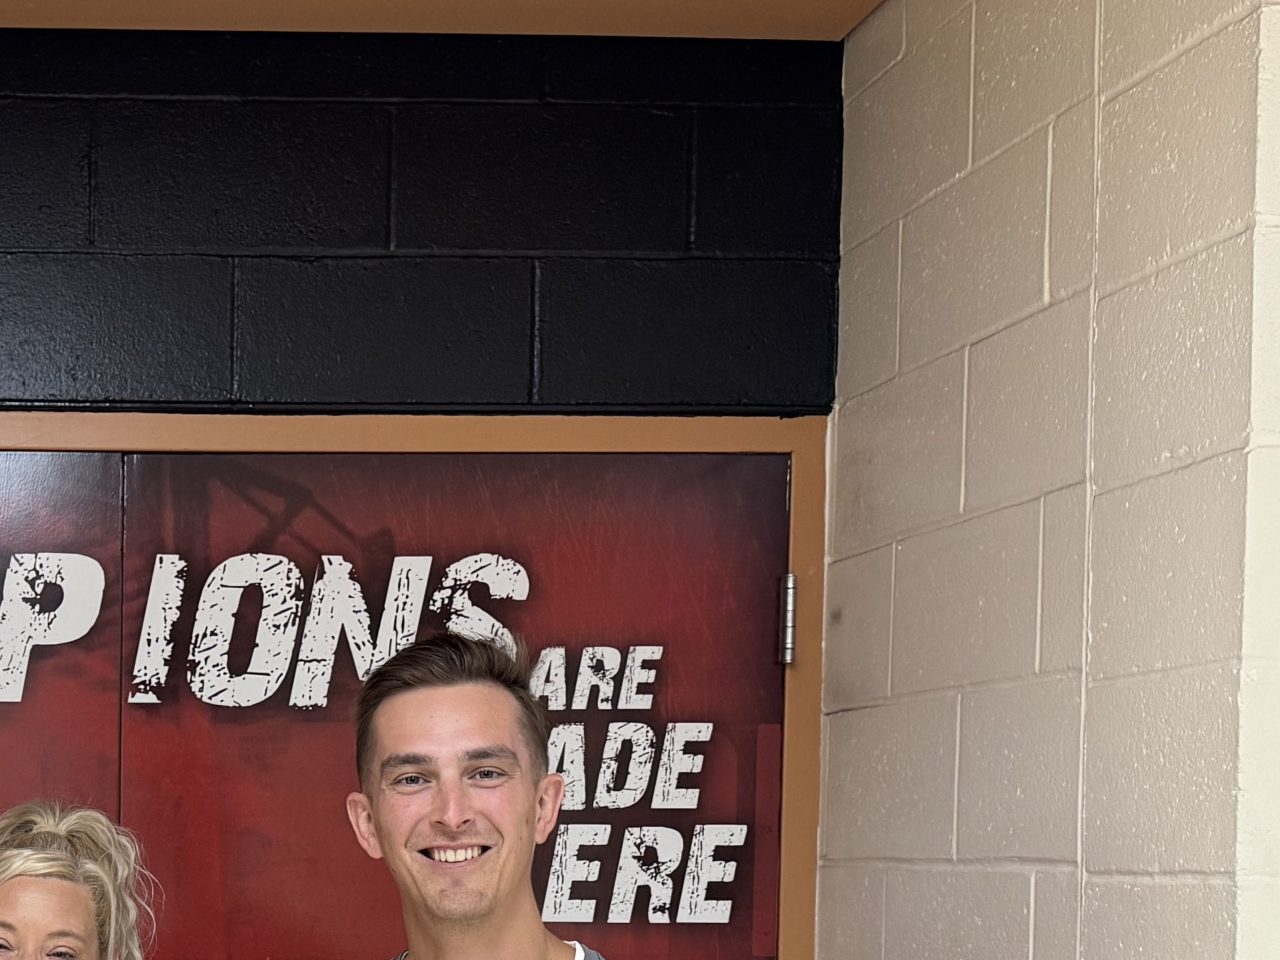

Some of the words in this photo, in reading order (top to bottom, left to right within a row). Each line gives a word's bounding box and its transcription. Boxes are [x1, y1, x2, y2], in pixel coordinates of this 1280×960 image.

[529, 645, 664, 711] ARE
[547, 721, 714, 811] ADE
[541, 823, 748, 924] ERE
